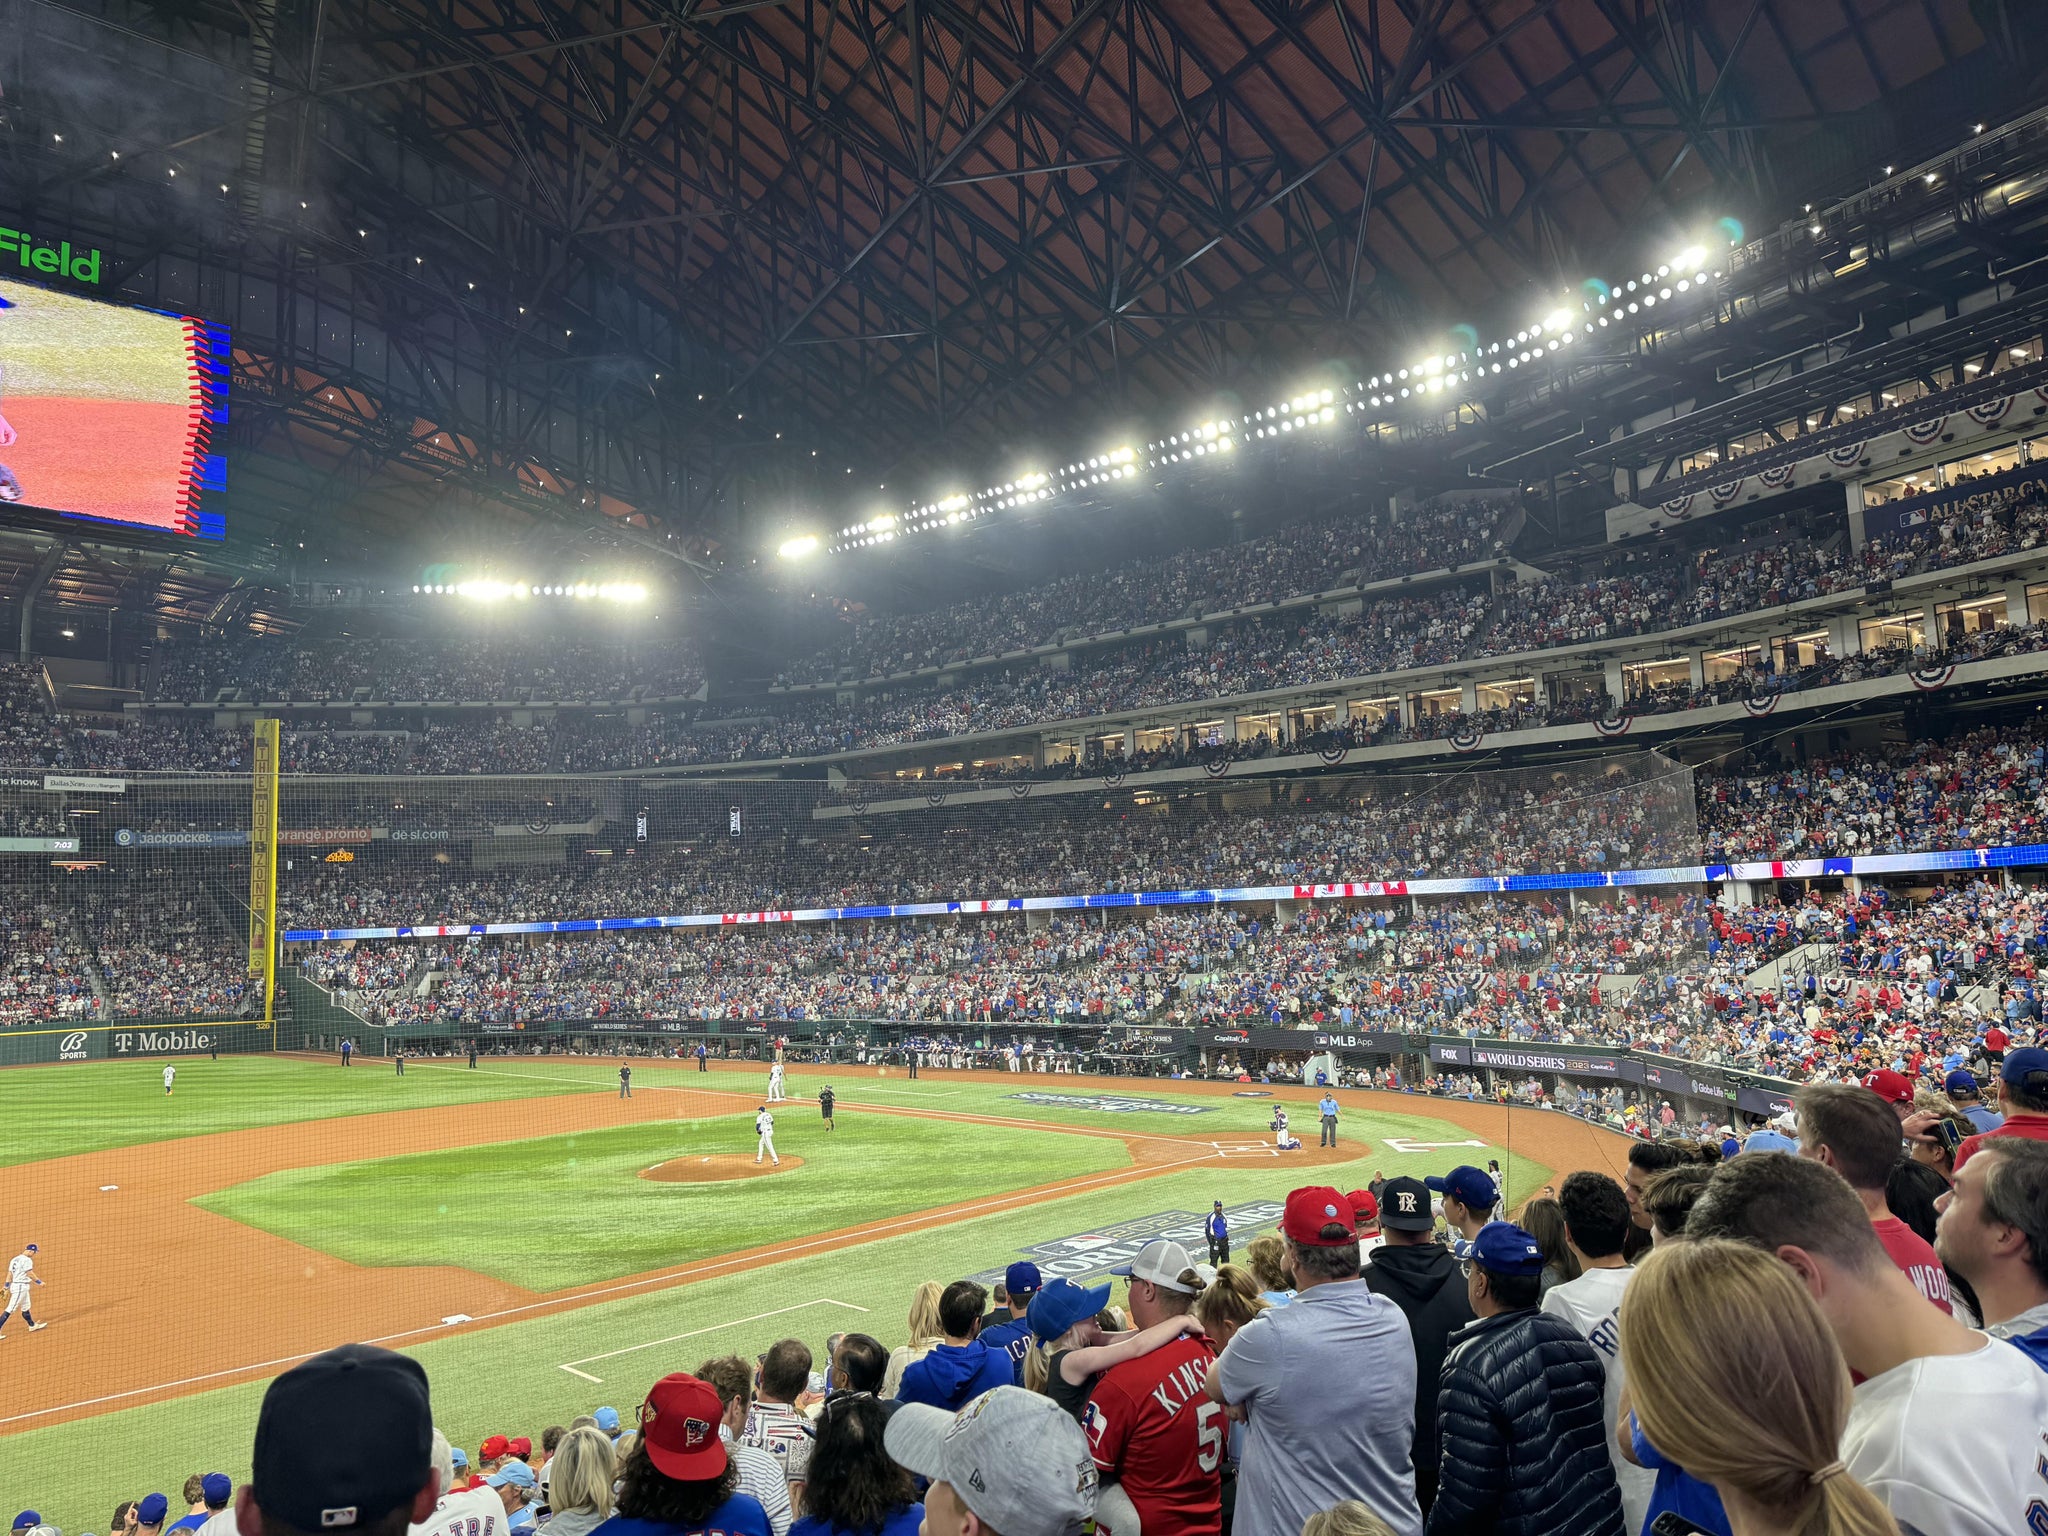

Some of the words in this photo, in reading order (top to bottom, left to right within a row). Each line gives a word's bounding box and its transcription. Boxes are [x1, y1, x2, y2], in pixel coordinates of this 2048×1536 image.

[0, 227, 100, 284] Field
[257, 748, 268, 788] THE
[11, 778, 40, 786] know.
[256, 801, 266, 842] HOT
[54, 841, 73, 849] 7:03
[139, 833, 213, 844] Jackpocket
[255, 854, 265, 909] ZONE
[256, 1022, 271, 1030] 326
[667, 1023, 680, 1031] MLB
[138, 1031, 210, 1051] Mobile
[1329, 1035, 1356, 1047] MLB
[1357, 1038, 1373, 1047] App
[60, 1051, 87, 1060] SPORTS
[1440, 1049, 1458, 1060] FOX
[1487, 1052, 1526, 1067] WORLD
[1526, 1056, 1566, 1070] SERIES
[1566, 1061, 1589, 1070] 2023
[1698, 1083, 1714, 1095] Globe
[1714, 1086, 1724, 1097] Life
[1724, 1090, 1737, 1100] Field
[1106, 1212, 1195, 1238] 2023
[1196, 1401, 1223, 1473] 5
